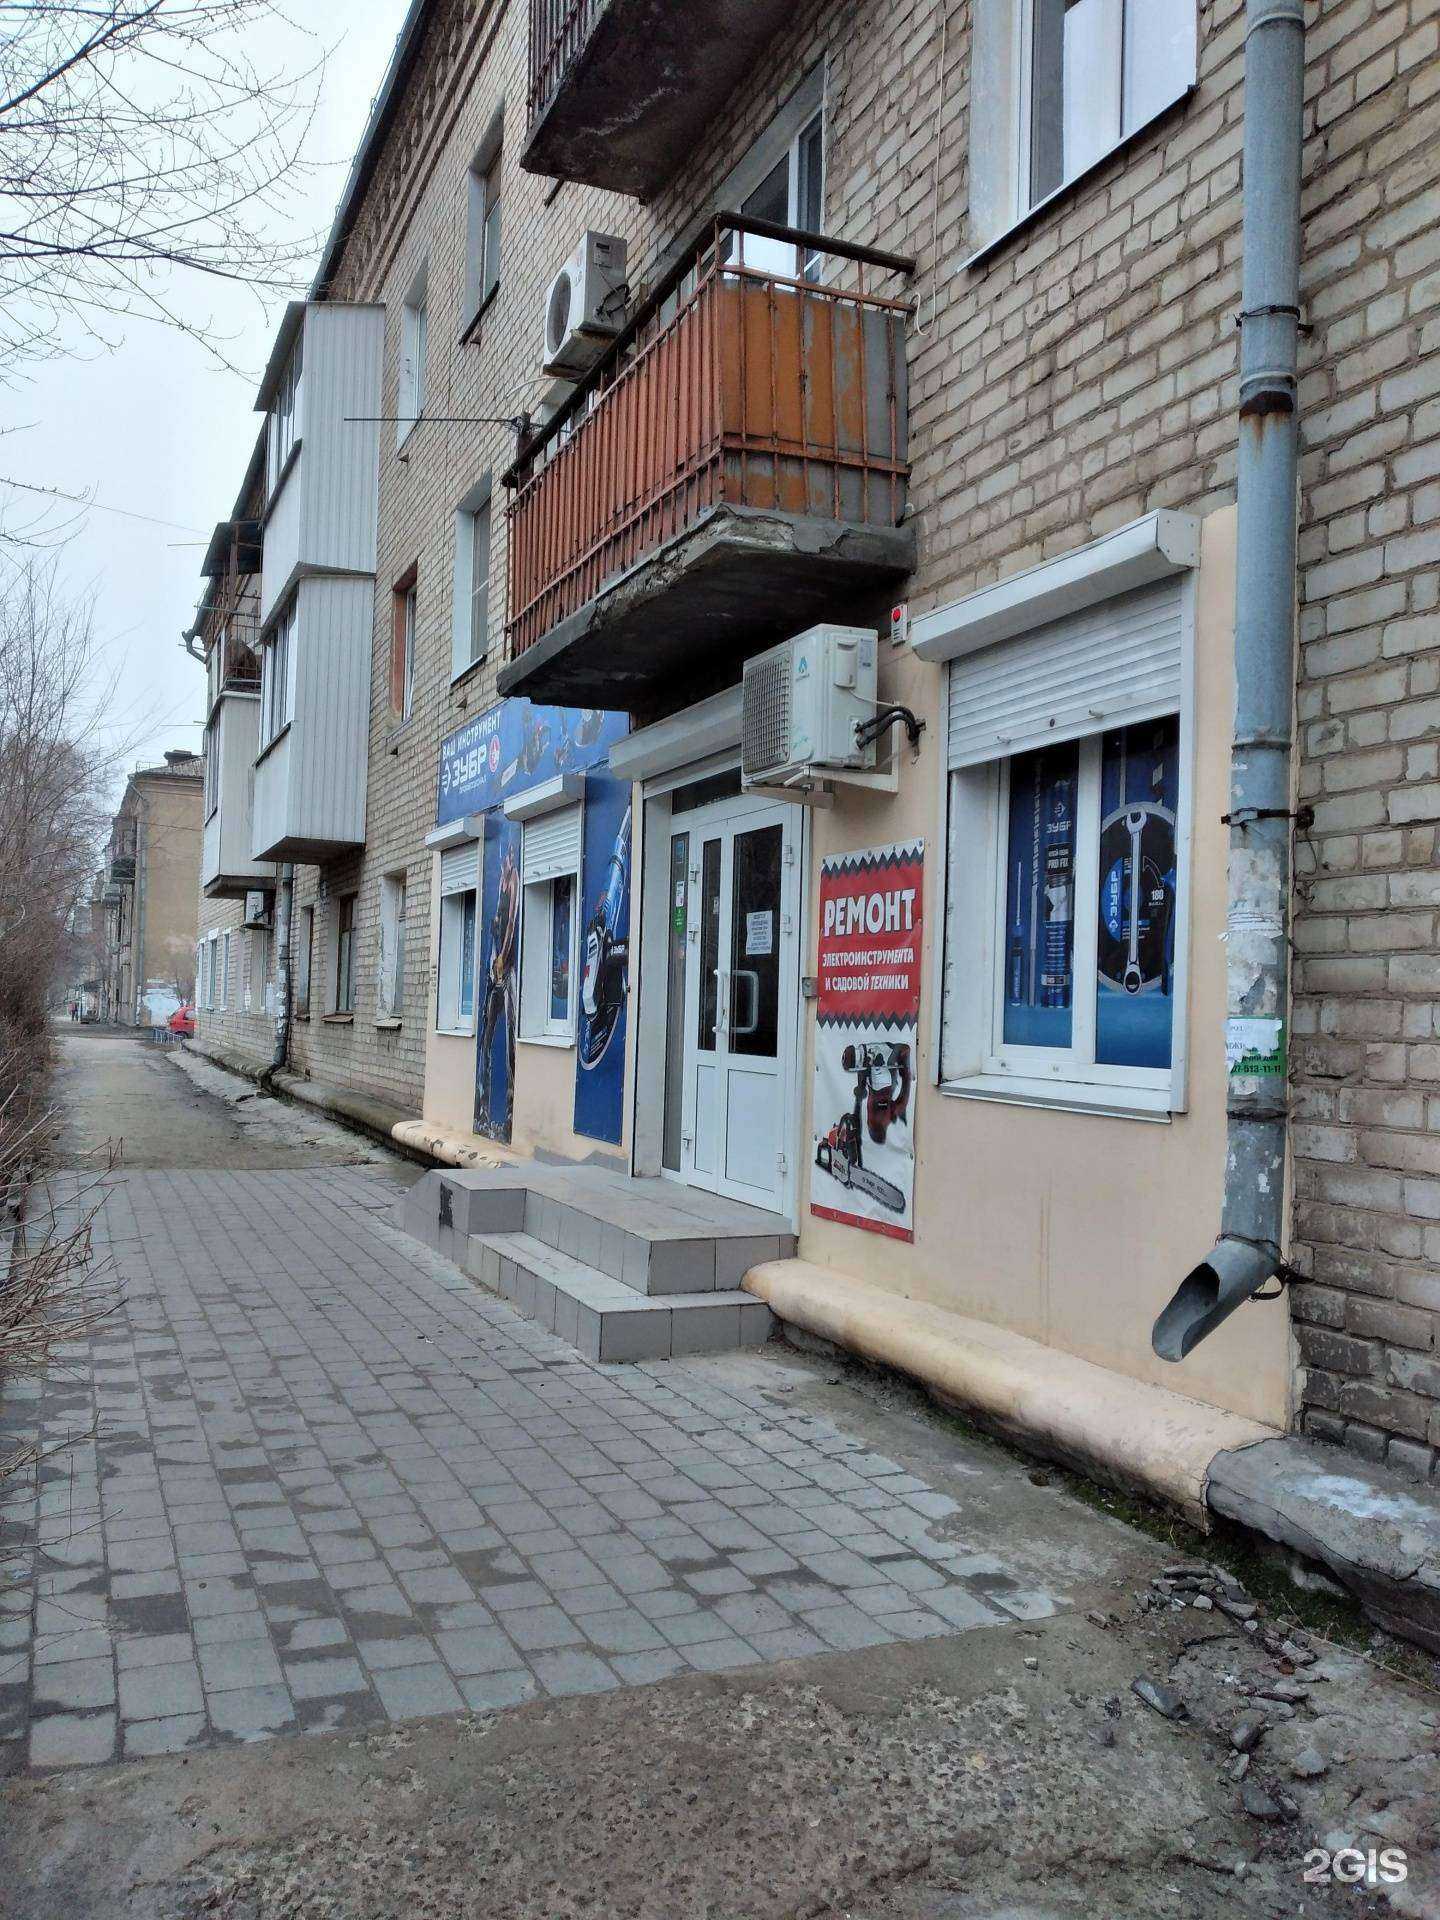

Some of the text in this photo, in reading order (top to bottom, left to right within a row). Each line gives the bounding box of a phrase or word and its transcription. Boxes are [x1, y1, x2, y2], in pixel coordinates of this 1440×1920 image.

[458, 711, 501, 753] ИНСТРУМЕНТ
[453, 744, 487, 787] ЗУБР
[824, 889, 915, 937] РЕМОНТ
[822, 947, 914, 967] ЭЛЕКТРОИНСТРУМЕНТА
[825, 972, 908, 991] И САДОВОЙ ТЕХНИКИ
